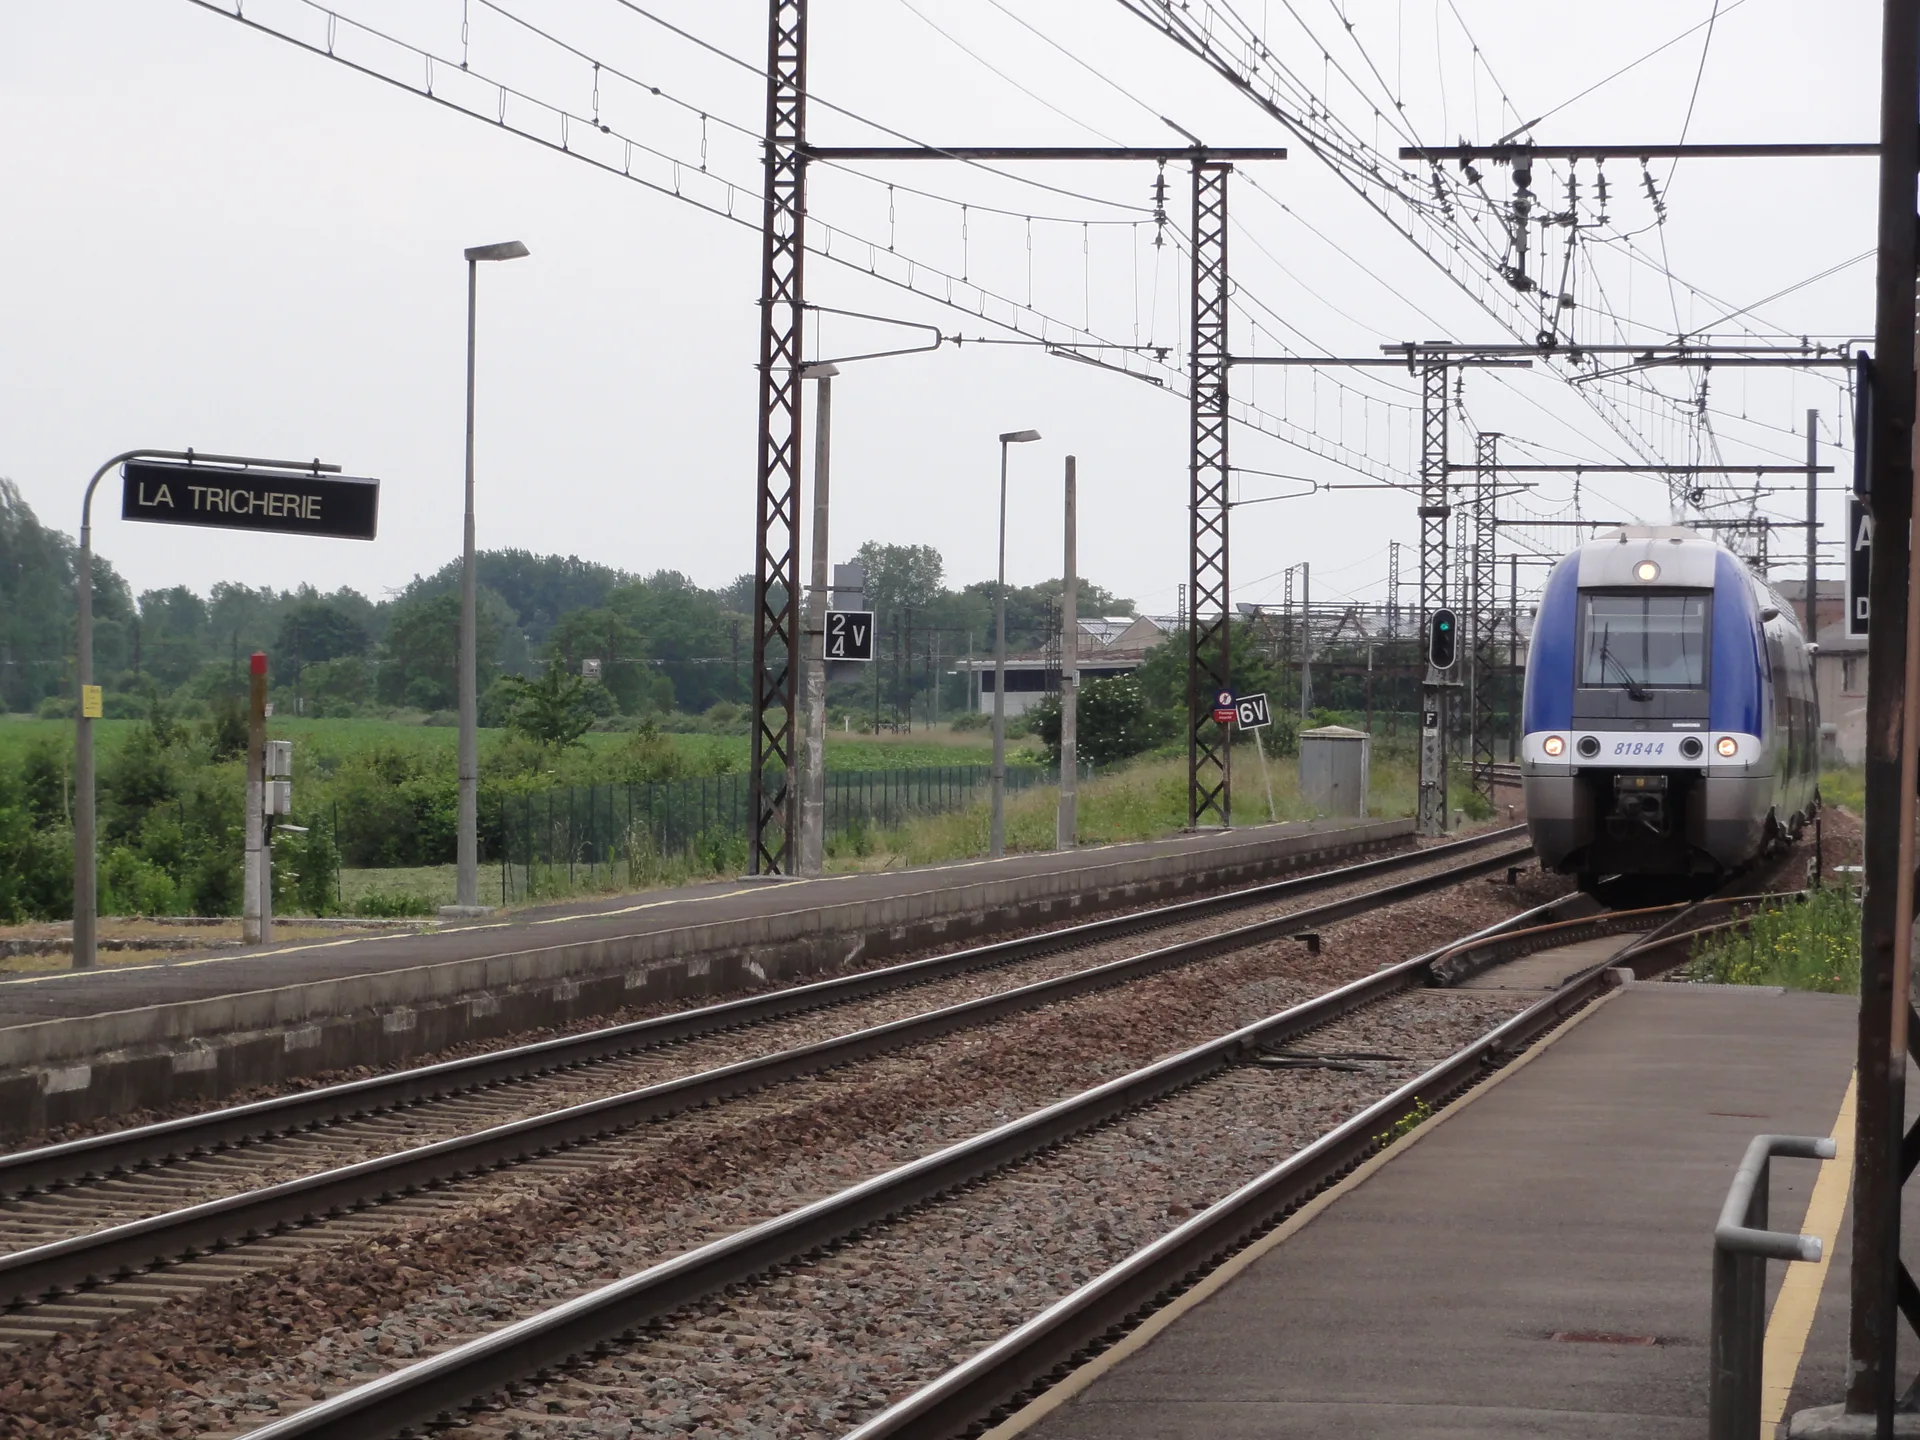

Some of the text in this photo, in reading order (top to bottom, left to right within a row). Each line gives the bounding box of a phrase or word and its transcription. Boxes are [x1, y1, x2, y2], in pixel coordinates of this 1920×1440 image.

[138, 482, 322, 520] LA TRICHERIE
[1240, 700, 1263, 723] 6V
[1427, 713, 1435, 725] F
[1614, 742, 1665, 756] 81844
